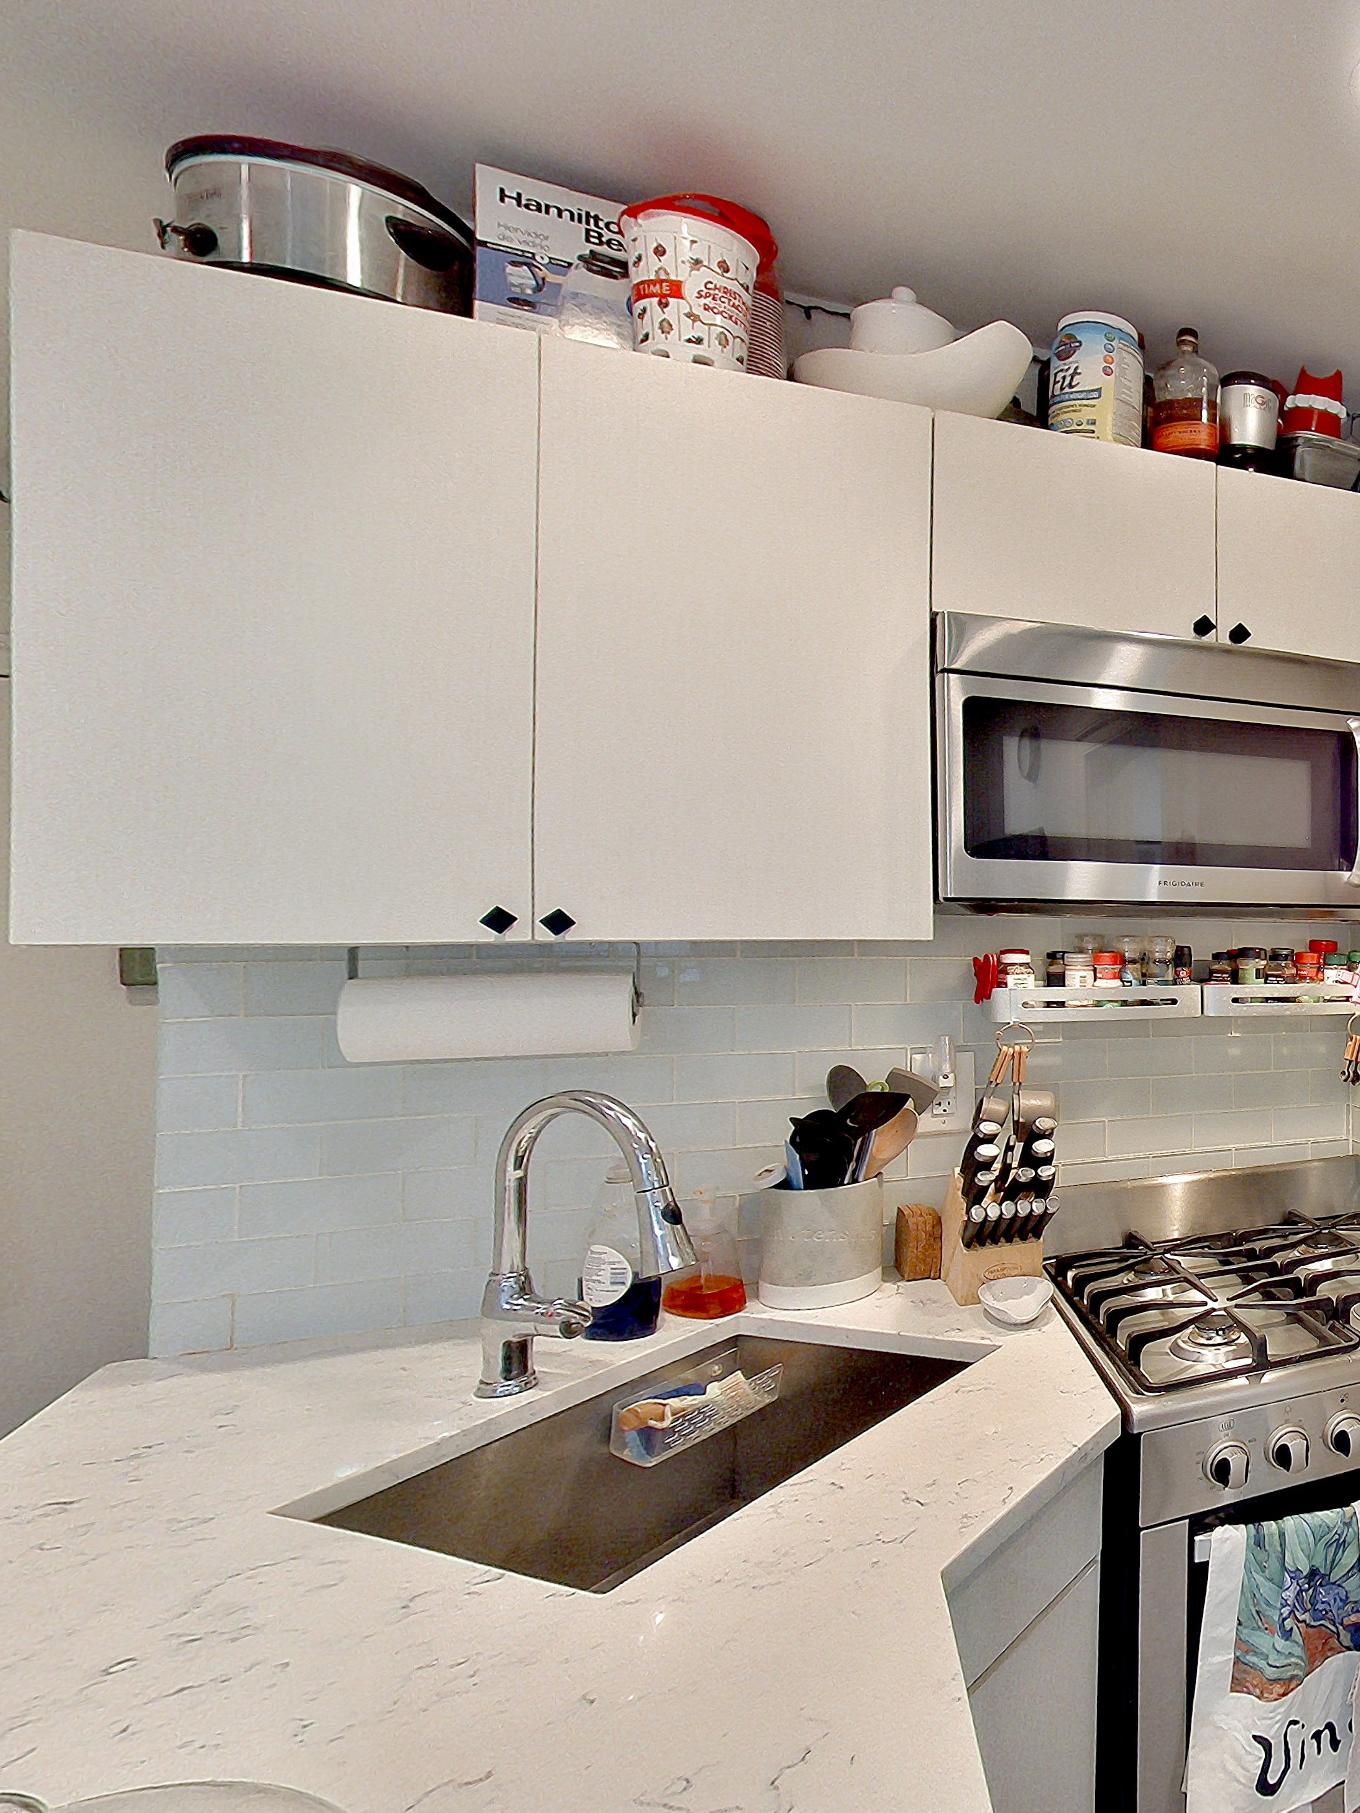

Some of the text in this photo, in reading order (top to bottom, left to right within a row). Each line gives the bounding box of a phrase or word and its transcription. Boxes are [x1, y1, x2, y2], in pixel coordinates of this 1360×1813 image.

[498, 186, 620, 234] Hamilto
[584, 228, 626, 253] Be
[1051, 365, 1082, 398] Fit
[1158, 880, 1206, 888] FRIGIDAIRE
[1251, 1718, 1352, 1797] Vin
